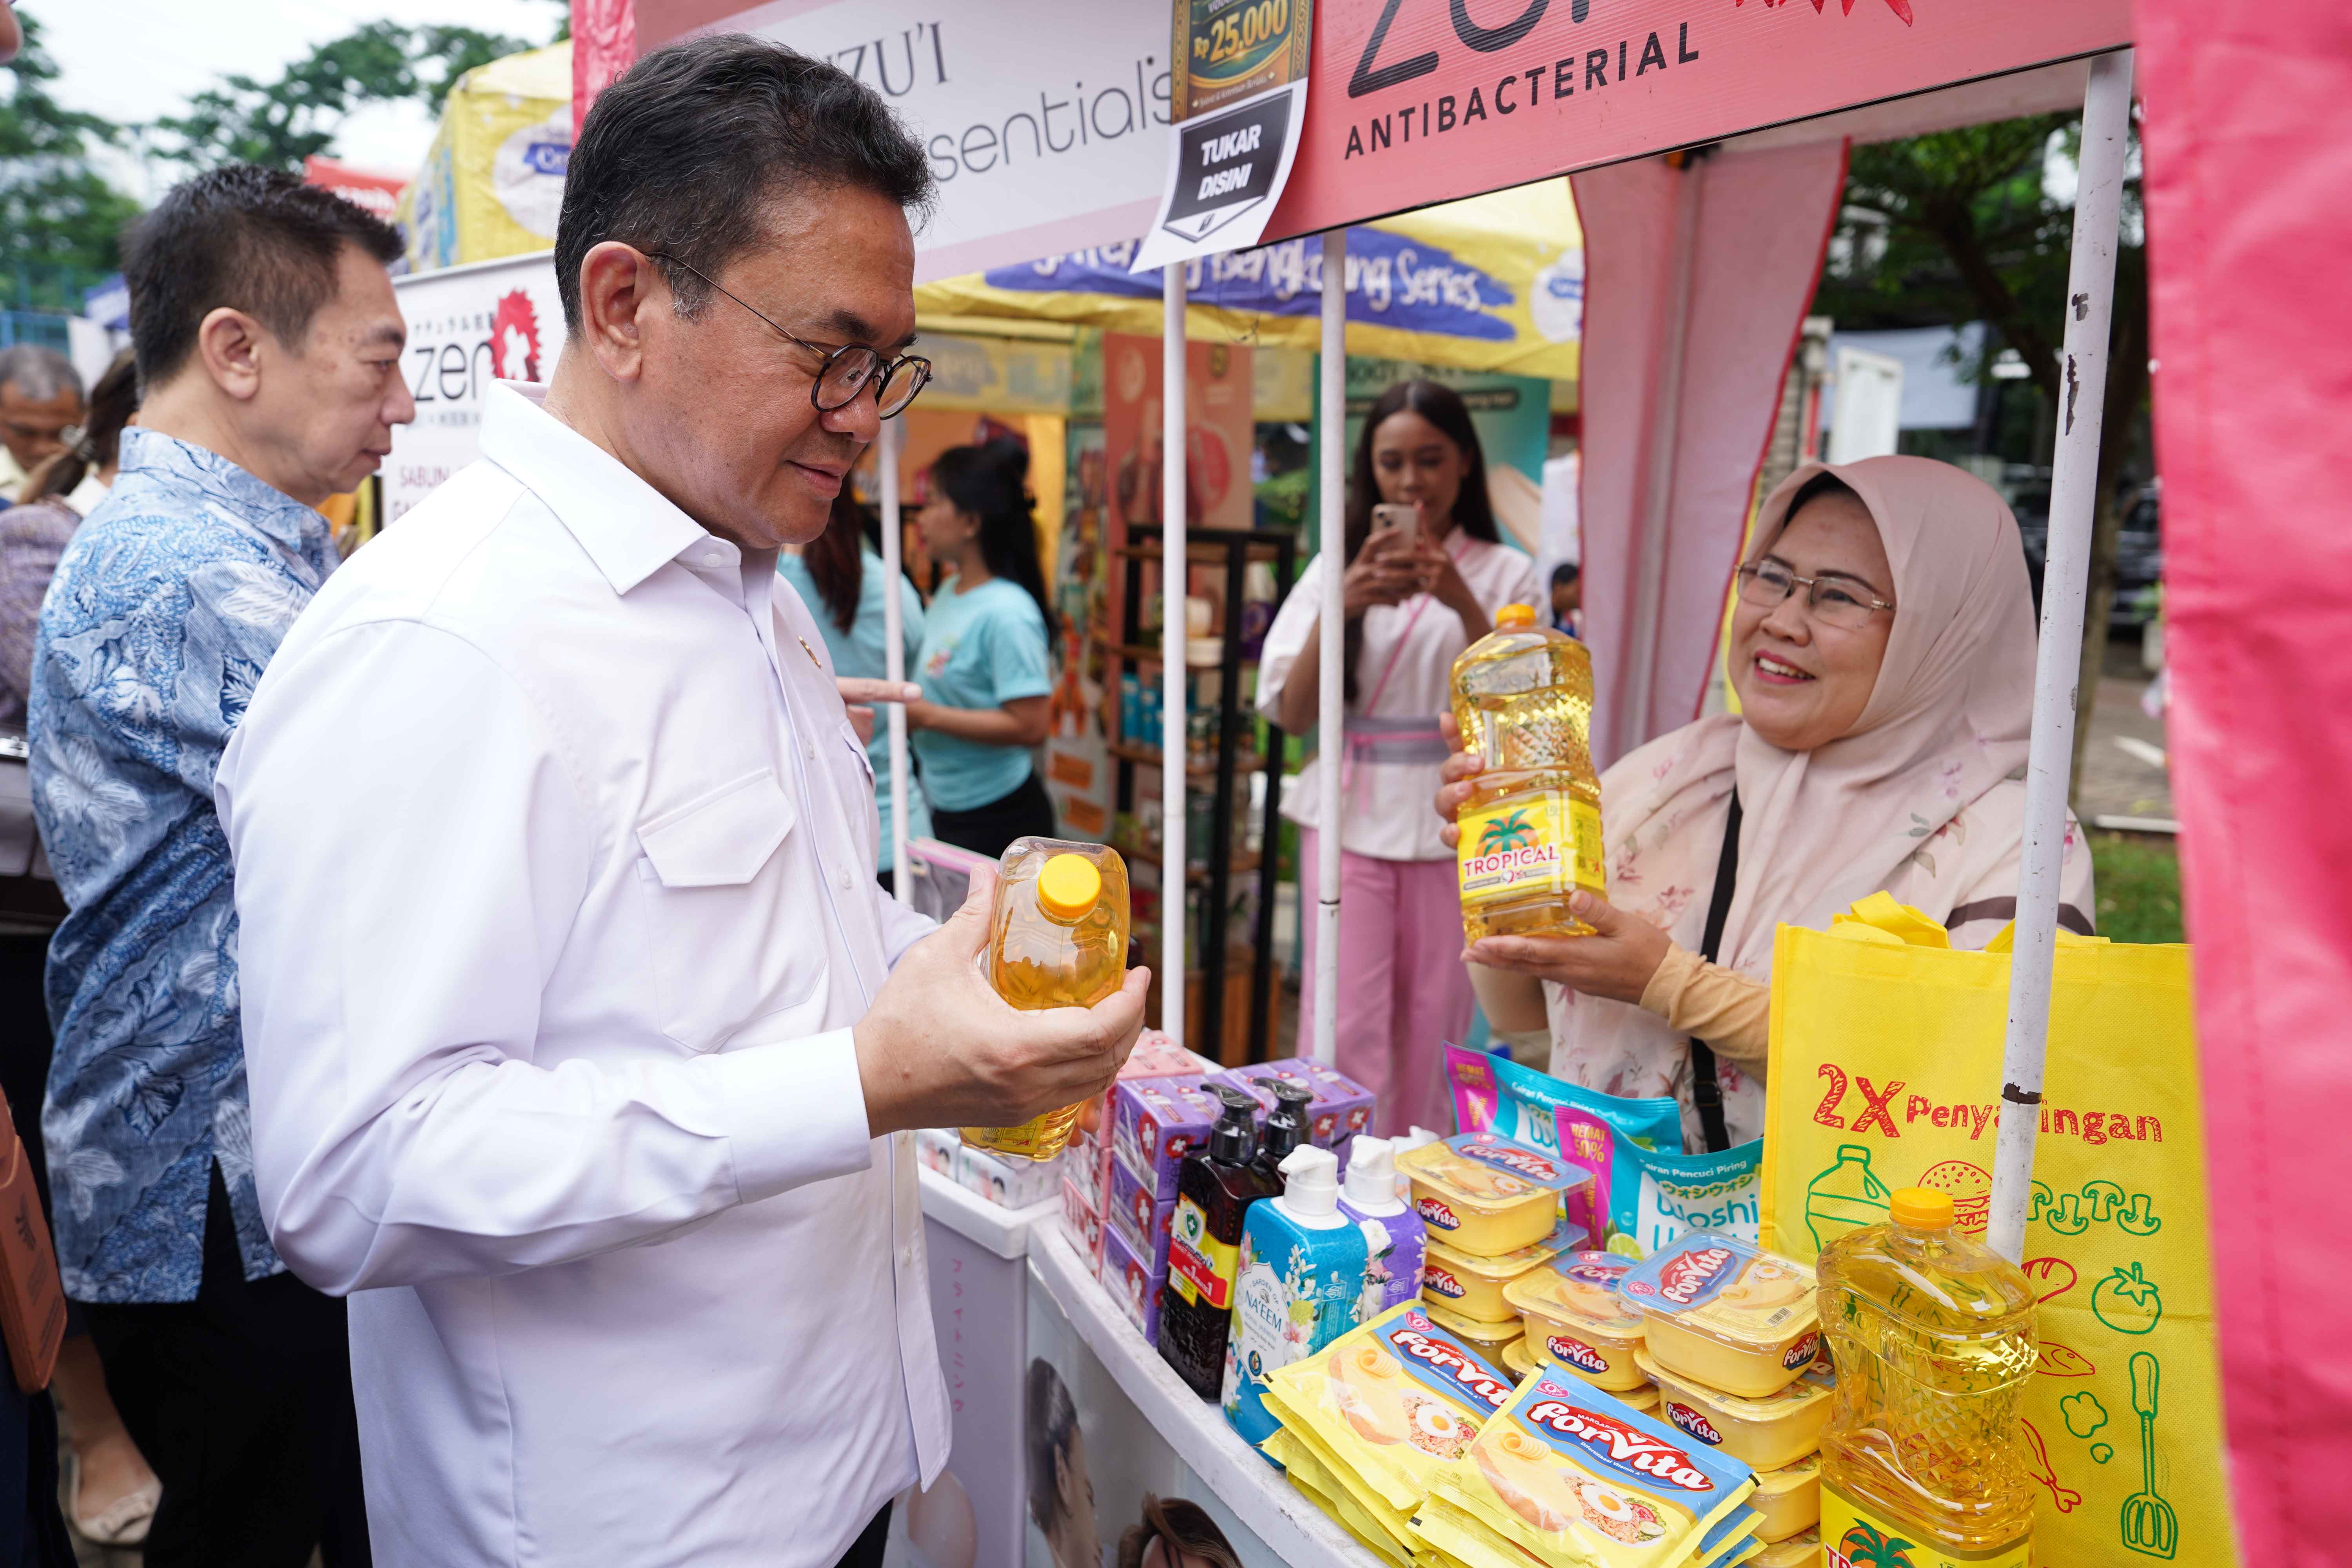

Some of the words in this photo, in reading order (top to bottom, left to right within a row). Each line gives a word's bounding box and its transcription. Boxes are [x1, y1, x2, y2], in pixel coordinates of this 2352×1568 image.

[1194, 36, 1210, 60] Rp
[1209, 0, 1288, 63] 25.000
[1345, 21, 1700, 160] ANTIBACTERIAL
[1201, 124, 1262, 166] TUKAR
[1197, 163, 1253, 201] DISINI
[1464, 846, 1559, 877] TROPICAL
[1813, 1063, 1906, 1138] 2X
[1906, 1094, 2163, 1145] Penyingan
[1571, 1122, 1606, 1142] HEMAT
[1574, 1138, 1605, 1163] 50%
[1672, 1168, 1714, 1178] Pencuci
[1717, 1160, 1747, 1173] Piring
[1252, 1279, 1272, 1292] GARDEN
[1245, 1290, 1281, 1332] NA'EEM
[1434, 1344, 1470, 1361] MARGARIN
[1392, 1331, 1513, 1406] forVit
[1577, 1414, 1619, 1430] MARGARIN
[1580, 1442, 1613, 1463] Difortifikasi
[1613, 1461, 1635, 1474] Vitamin
[1450, 1470, 1463, 1483] 200g
